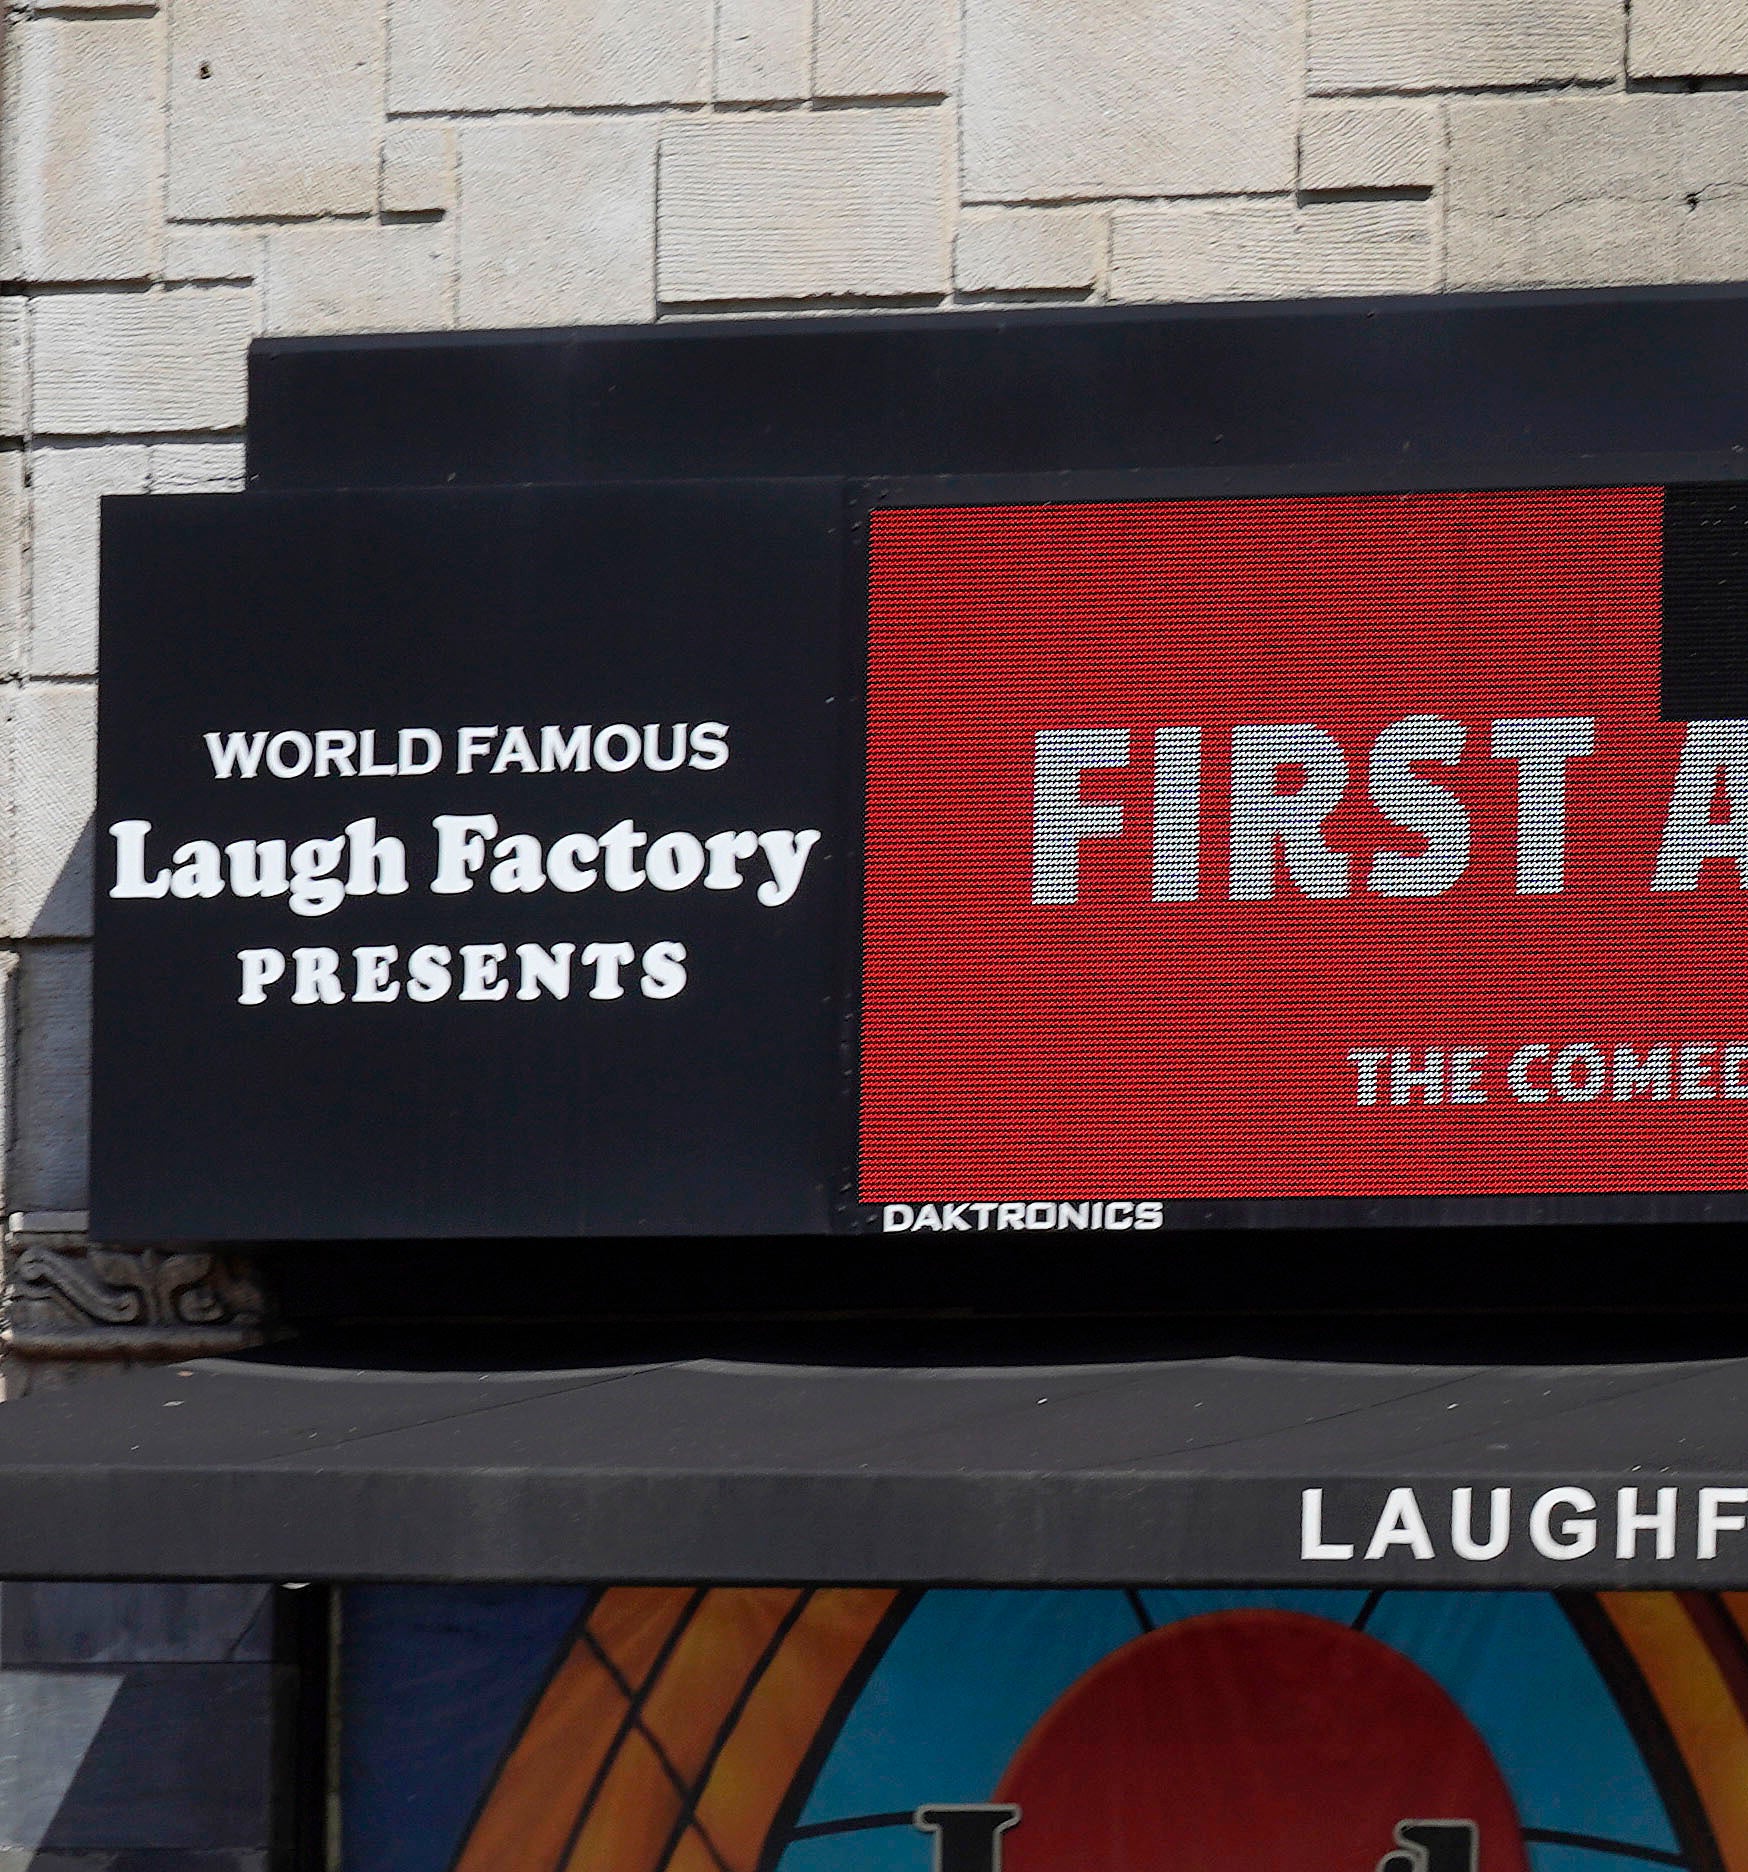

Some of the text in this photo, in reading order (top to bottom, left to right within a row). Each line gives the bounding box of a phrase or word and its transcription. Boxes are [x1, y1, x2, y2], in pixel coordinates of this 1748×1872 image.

[204, 722, 730, 779] WORLD FAMOUS
[1031, 715, 1594, 905] FIRST
[108, 813, 821, 917] Laugh Factory
[236, 941, 689, 1006] PRESENTS
[1348, 1045, 1490, 1107] THE
[882, 1202, 1165, 1234] DAKTRONICS
